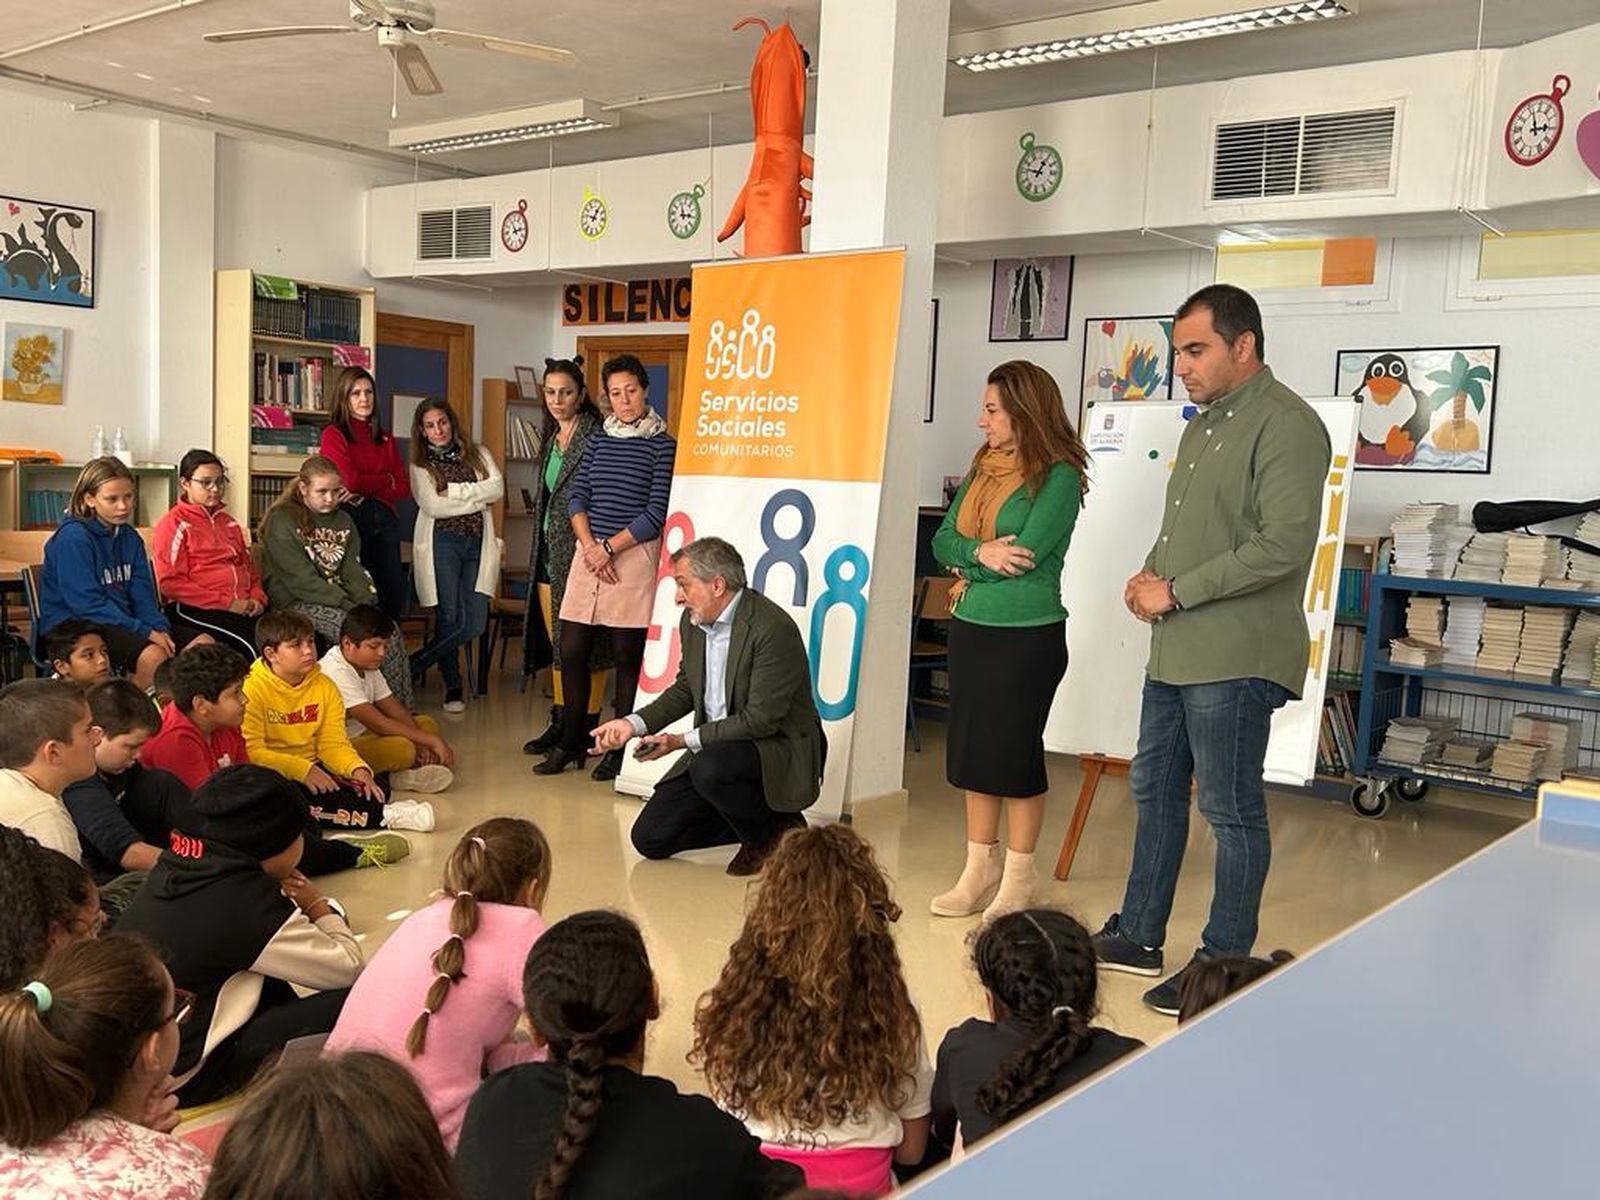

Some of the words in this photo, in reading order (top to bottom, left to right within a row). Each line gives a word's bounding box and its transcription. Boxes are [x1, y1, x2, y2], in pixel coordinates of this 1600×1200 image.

[700, 390, 799, 412] Servicios
[696, 414, 786, 437] Sociales
[693, 442, 795, 457] COMUNITARIOS
